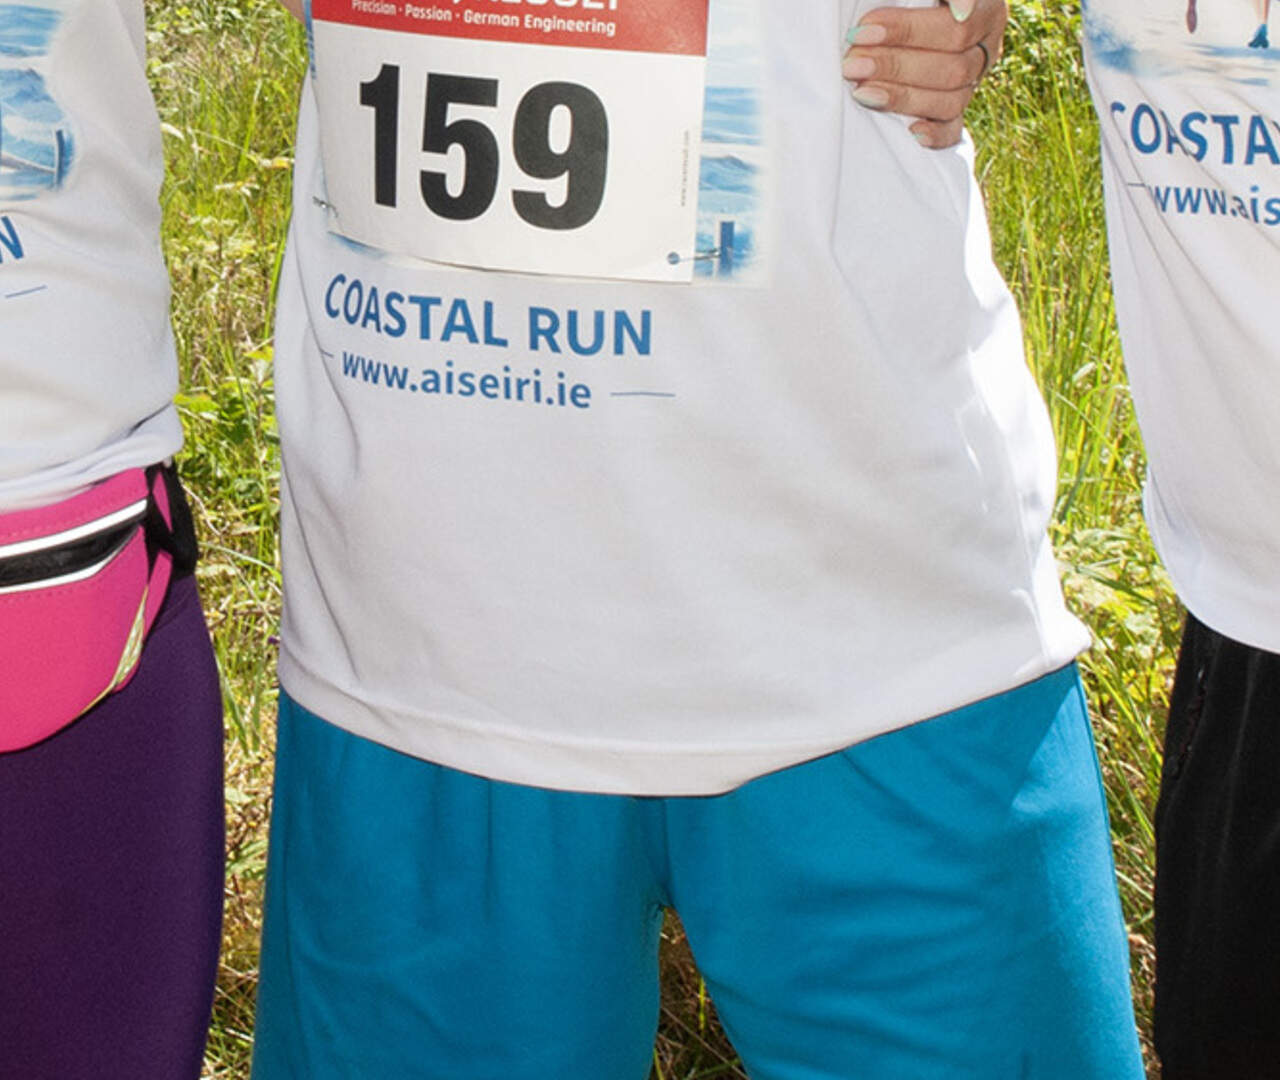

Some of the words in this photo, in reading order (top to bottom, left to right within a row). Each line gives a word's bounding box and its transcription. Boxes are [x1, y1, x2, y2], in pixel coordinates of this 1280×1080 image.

[405, 3, 453, 22] Passion
[463, 9, 520, 27] German
[523, 13, 616, 38] Engineering
[359, 63, 609, 231] 159
[326, 275, 508, 347] COASTAL
[530, 307, 651, 355] RUN
[342, 351, 592, 409] www.aiseiri.ie
